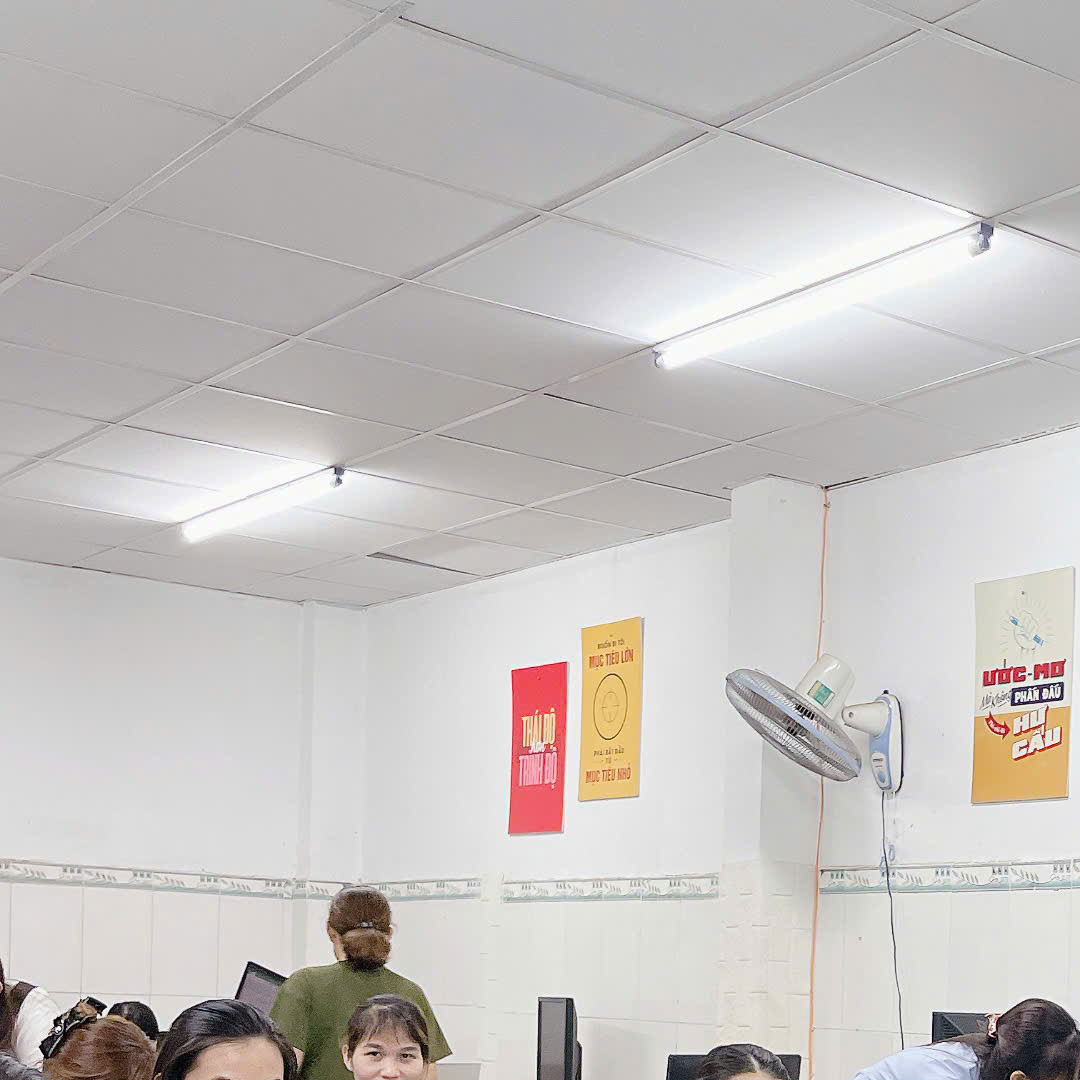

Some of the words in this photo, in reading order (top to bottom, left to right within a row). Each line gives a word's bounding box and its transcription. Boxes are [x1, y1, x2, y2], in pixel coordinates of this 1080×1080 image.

[1014, 686, 1040, 704] PHẤN
[1041, 683, 1062, 700] ĐẤU
[1013, 704, 1049, 736] HƯ
[1012, 724, 1063, 761] CẤU
